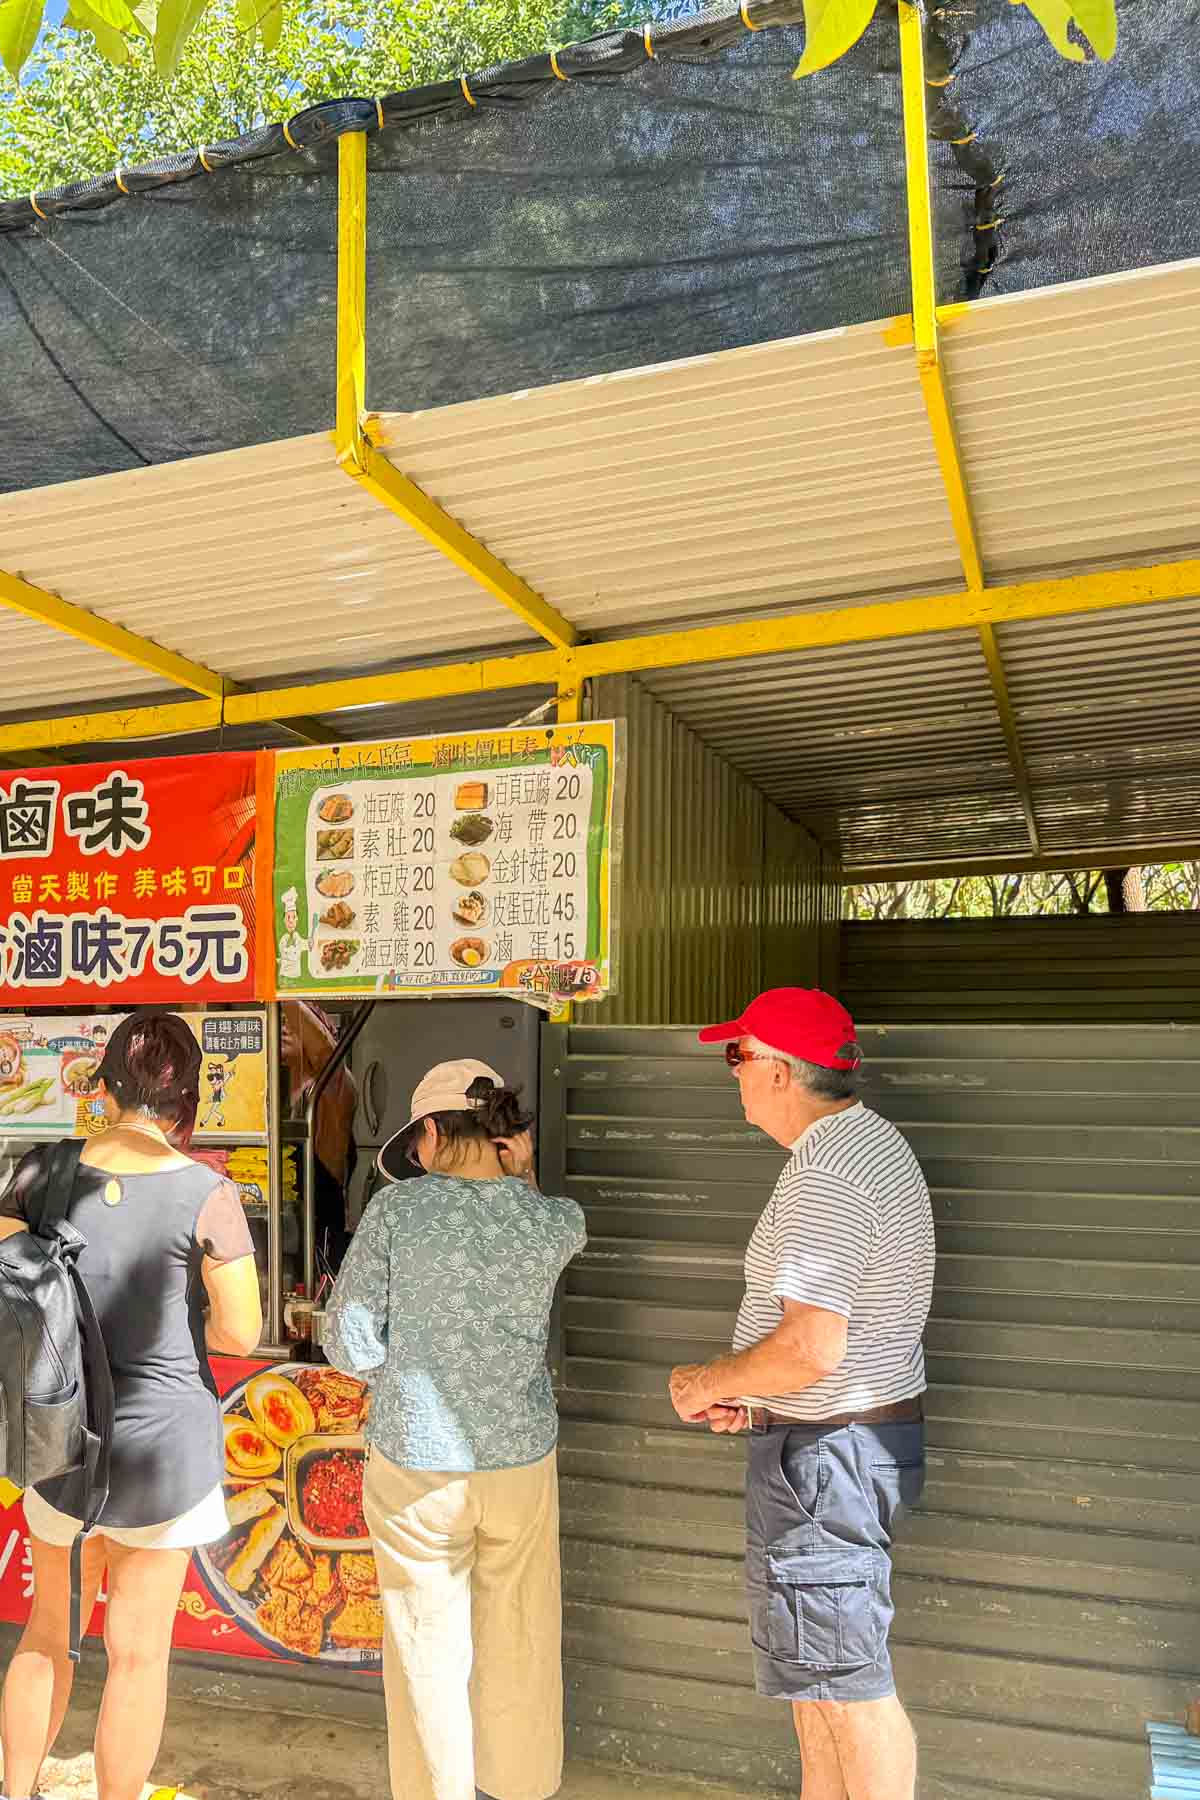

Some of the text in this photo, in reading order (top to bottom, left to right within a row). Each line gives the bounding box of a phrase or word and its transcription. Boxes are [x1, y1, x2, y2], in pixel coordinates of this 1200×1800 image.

[556, 775, 580, 800] 20
[414, 792, 435, 817] 20
[553, 813, 576, 839] 20
[412, 827, 434, 852] 20
[492, 848, 576, 884] 金針菇 20
[12, 871, 118, 904] 當天製作
[133, 865, 246, 898] 美味可口
[363, 864, 434, 898] 炸豆皮 20
[413, 905, 435, 930] 20
[493, 889, 575, 926] 皮蛋豆花 45
[413, 941, 435, 966] 20
[553, 932, 575, 959] 15
[205, 1020, 260, 1033] 自選滷味
